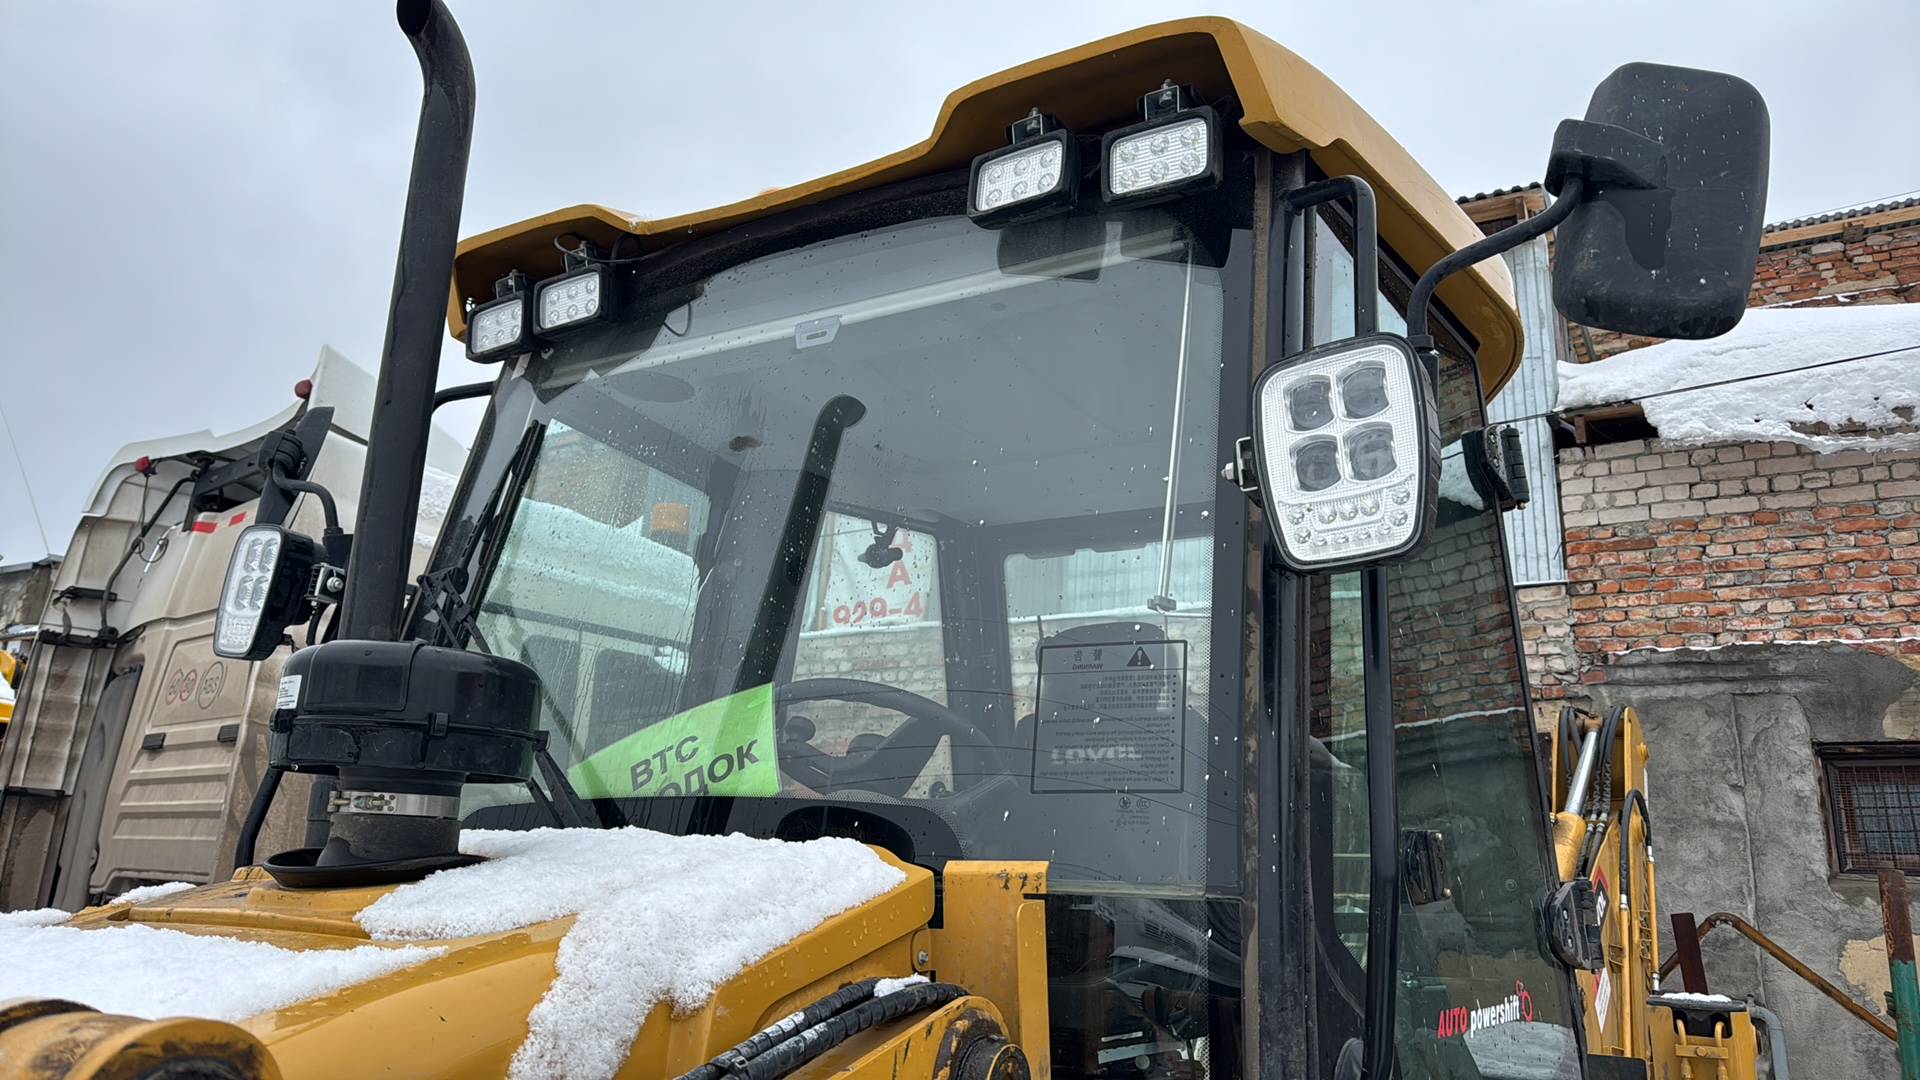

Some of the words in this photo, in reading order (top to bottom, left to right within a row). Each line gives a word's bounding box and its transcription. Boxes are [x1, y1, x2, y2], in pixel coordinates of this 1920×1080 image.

[630, 735, 700, 792] ВТС
[1438, 1006, 1468, 1039] AUTO
[1470, 994, 1520, 1039] powershift
